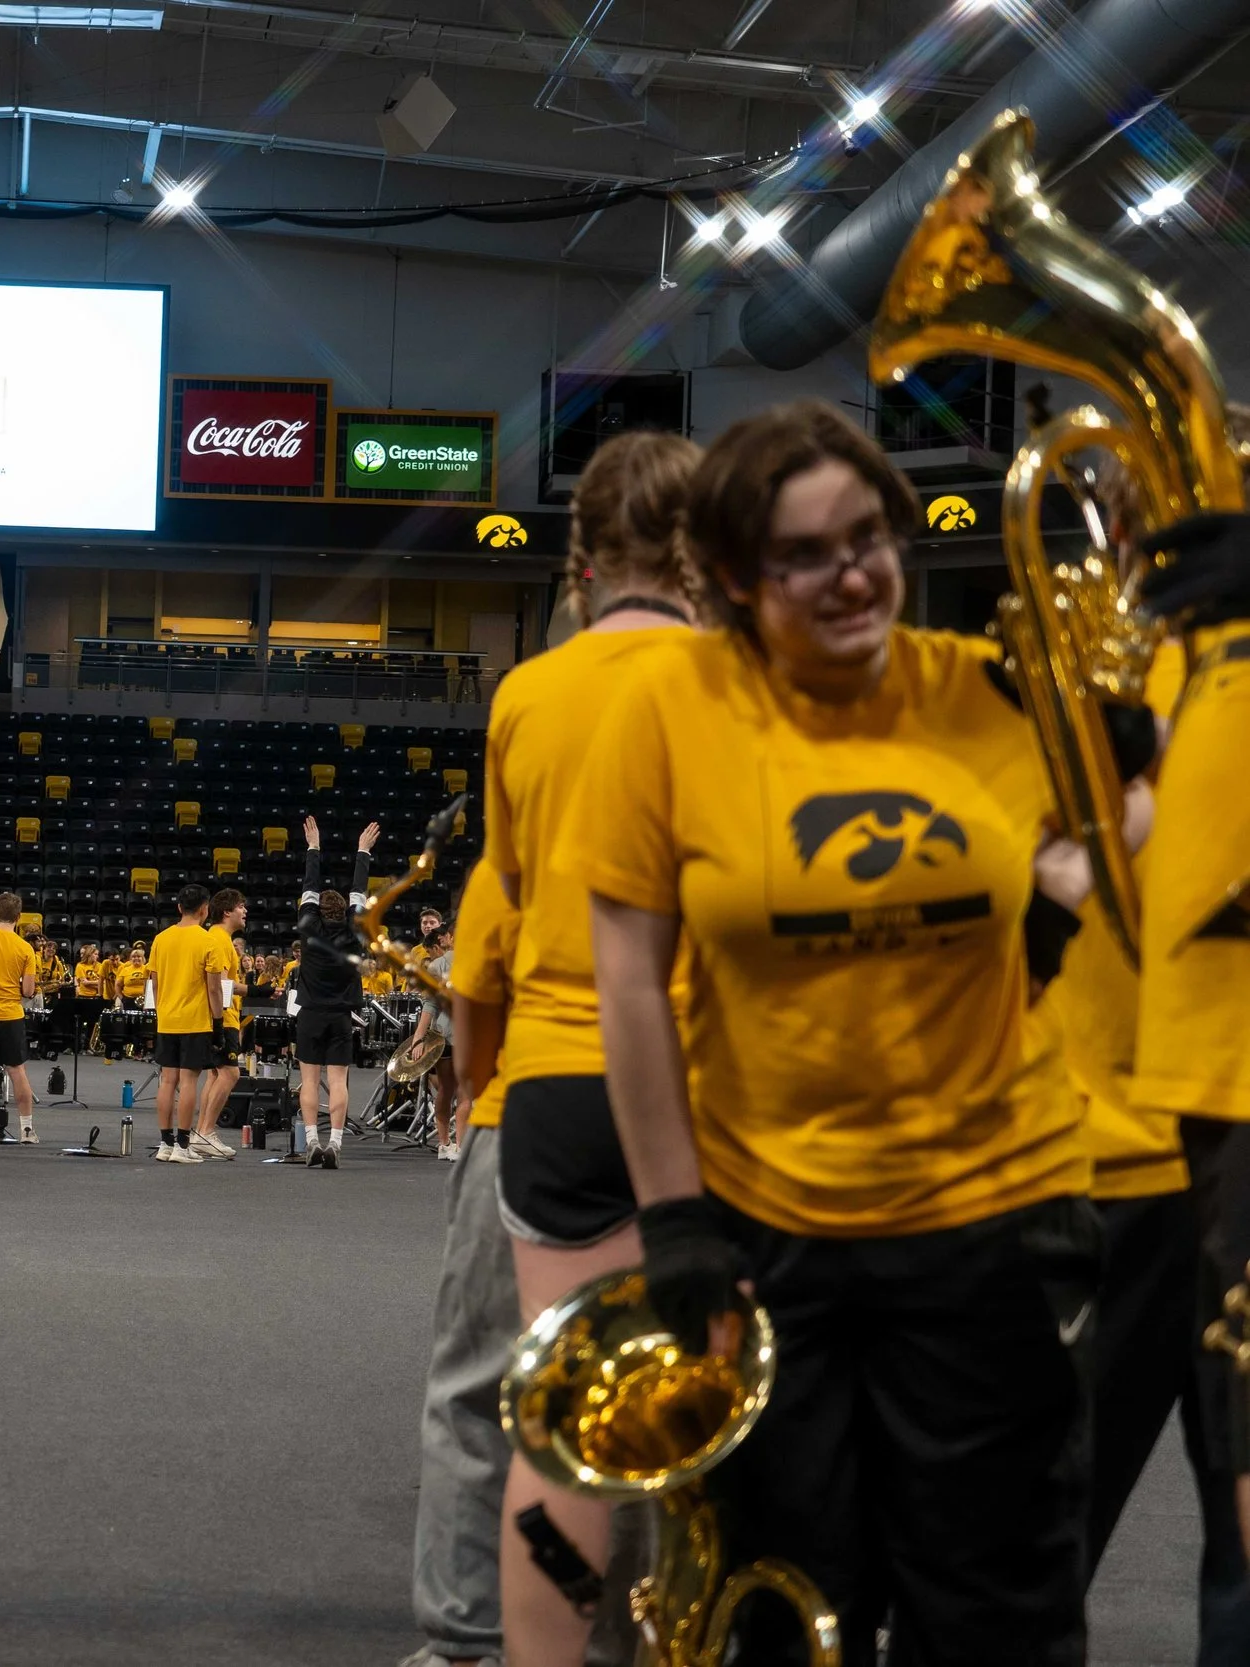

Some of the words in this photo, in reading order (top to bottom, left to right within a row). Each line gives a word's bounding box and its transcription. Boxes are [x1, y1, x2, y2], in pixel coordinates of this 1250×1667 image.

[187, 416, 311, 459] Coca-Cola
[388, 444, 479, 462] GreenState
[397, 461, 435, 471] CREDIT
[436, 463, 470, 472] UNION
